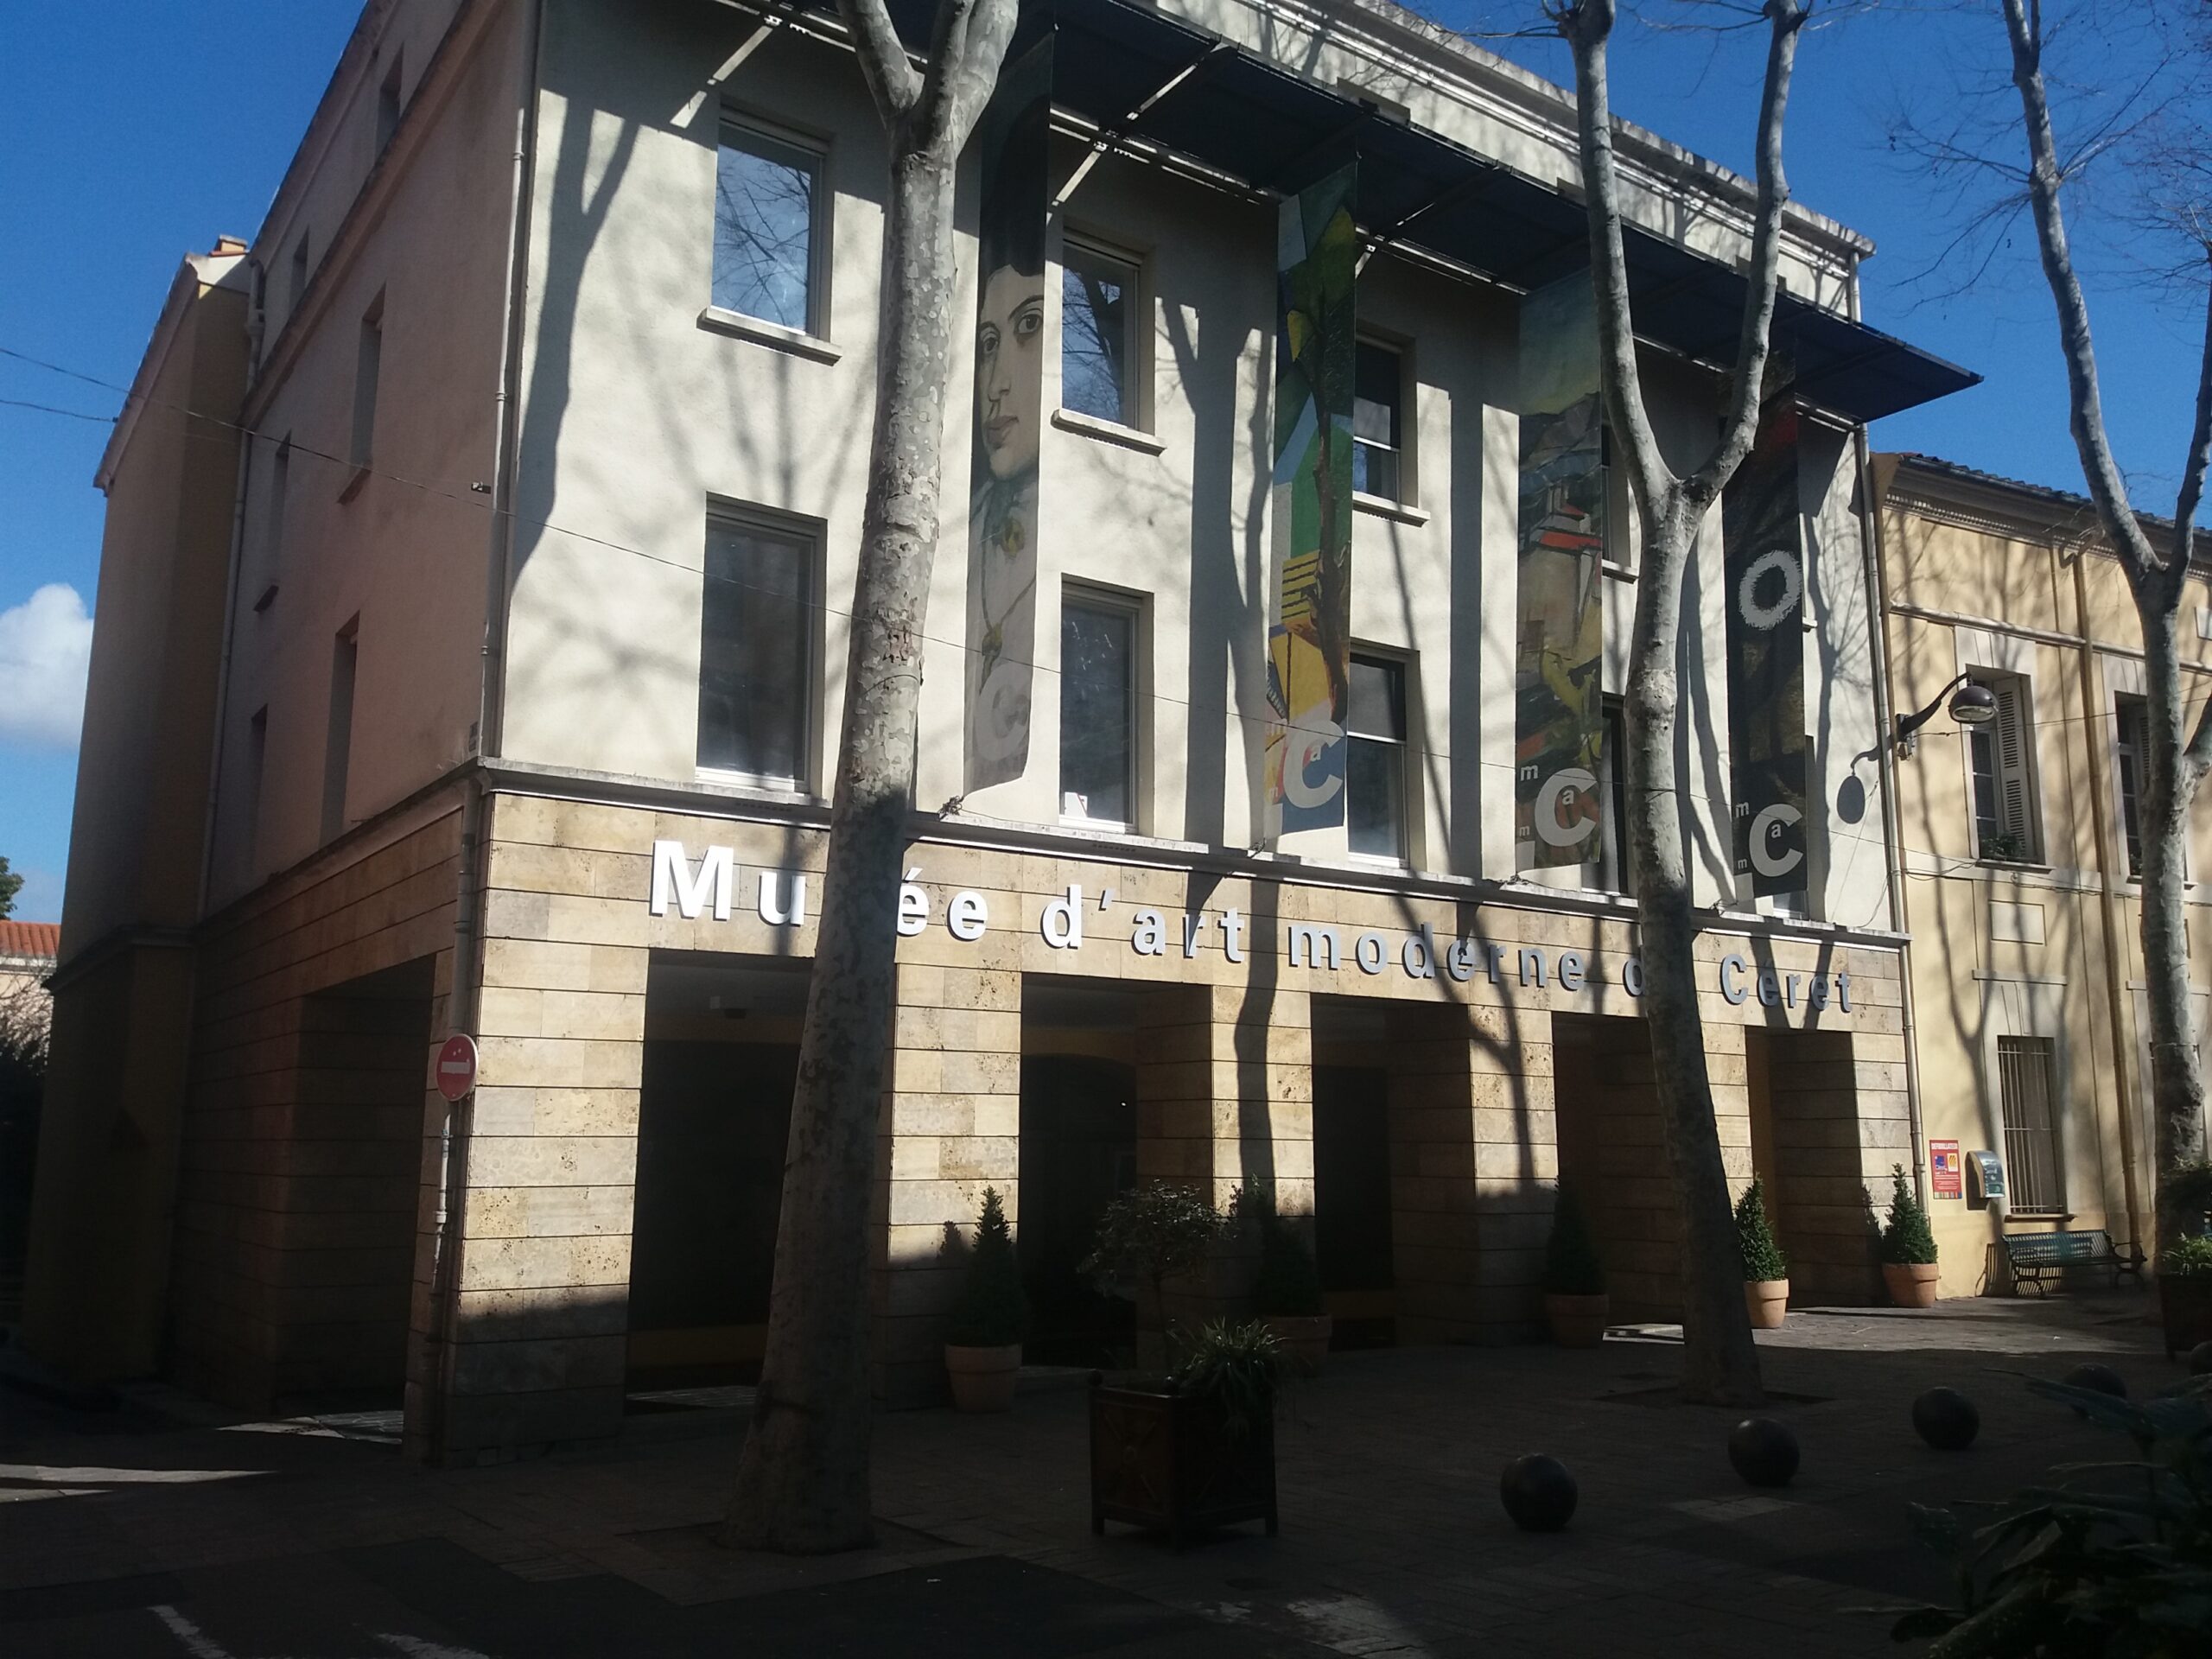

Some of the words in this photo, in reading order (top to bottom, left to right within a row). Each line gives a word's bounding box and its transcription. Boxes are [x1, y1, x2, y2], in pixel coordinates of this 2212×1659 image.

[650, 839, 988, 940] Muée
[1041, 883, 1246, 963] d'art
[1288, 921, 1586, 991] moderne
